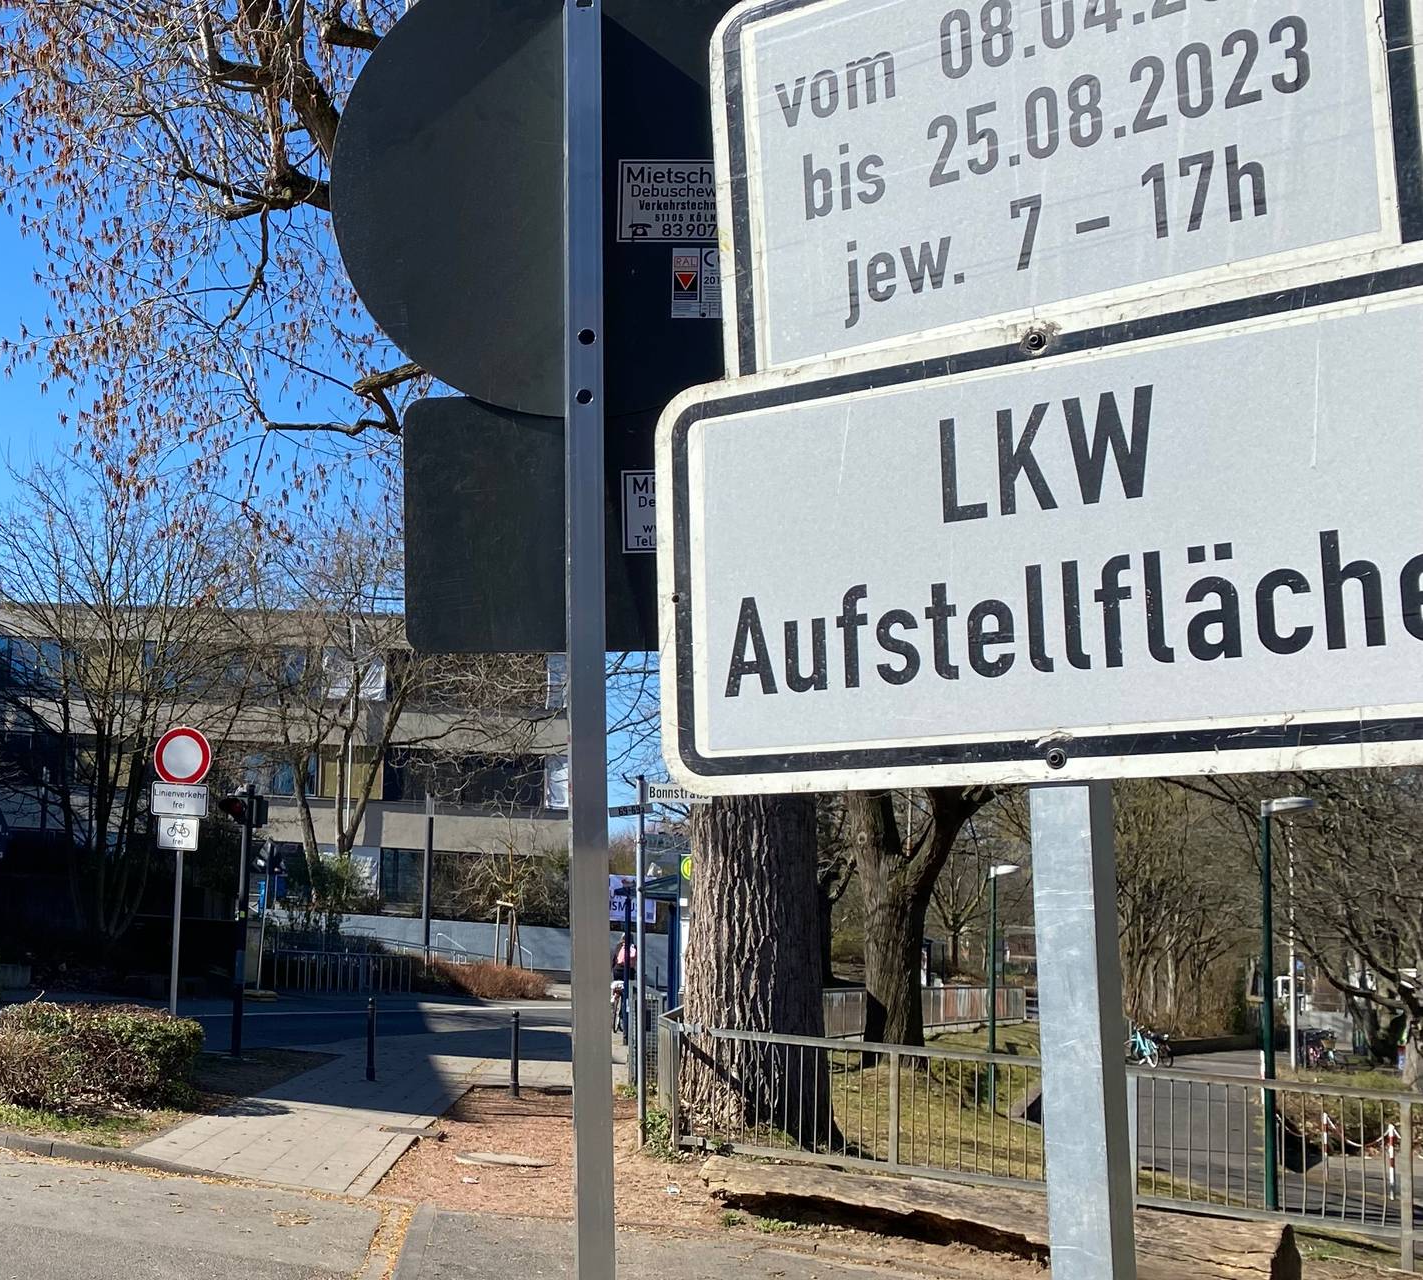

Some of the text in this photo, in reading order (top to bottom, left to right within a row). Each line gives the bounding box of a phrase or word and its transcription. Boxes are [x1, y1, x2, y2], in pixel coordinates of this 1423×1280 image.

[775, 0, 1215, 129] vom 08.04.
[803, 14, 1312, 221] bis 25.08.2023
[844, 236, 966, 329] jew.
[1009, 194, 1043, 272] 7
[1141, 144, 1269, 240] 17h
[939, 383, 1154, 524] LKW
[154, 788, 207, 800] Linienverkehr
[172, 801, 186, 809] frei
[649, 786, 709, 799] Bonnstra
